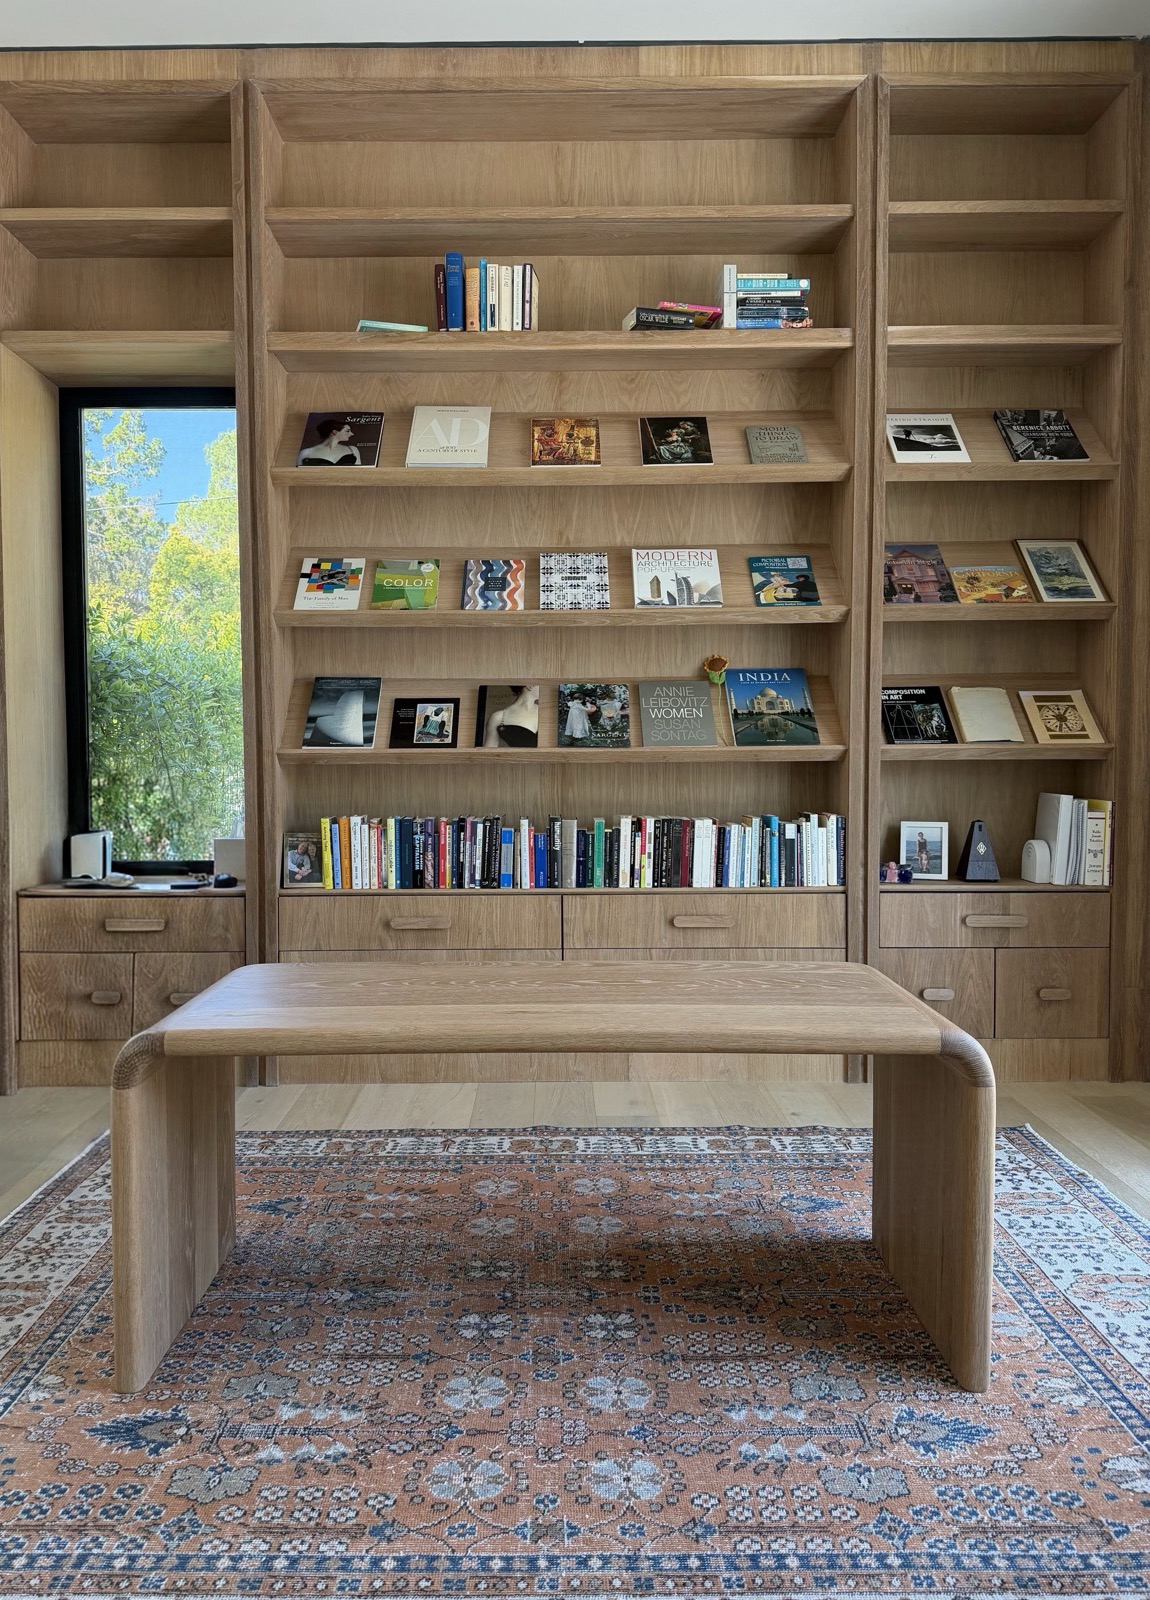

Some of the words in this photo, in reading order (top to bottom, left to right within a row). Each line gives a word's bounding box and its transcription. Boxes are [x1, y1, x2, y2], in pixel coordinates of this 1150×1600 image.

[412, 417, 488, 446] AD
[636, 551, 712, 560] MODERN
[739, 673, 791, 681] INDIA
[654, 687, 694, 696] ANNIE
[642, 697, 709, 707] LEIBOVITZ
[649, 708, 703, 718] WOMEN
[654, 719, 700, 729] SUSAN
[651, 730, 706, 740] SONTAG
[553, 822, 561, 850] humanity
